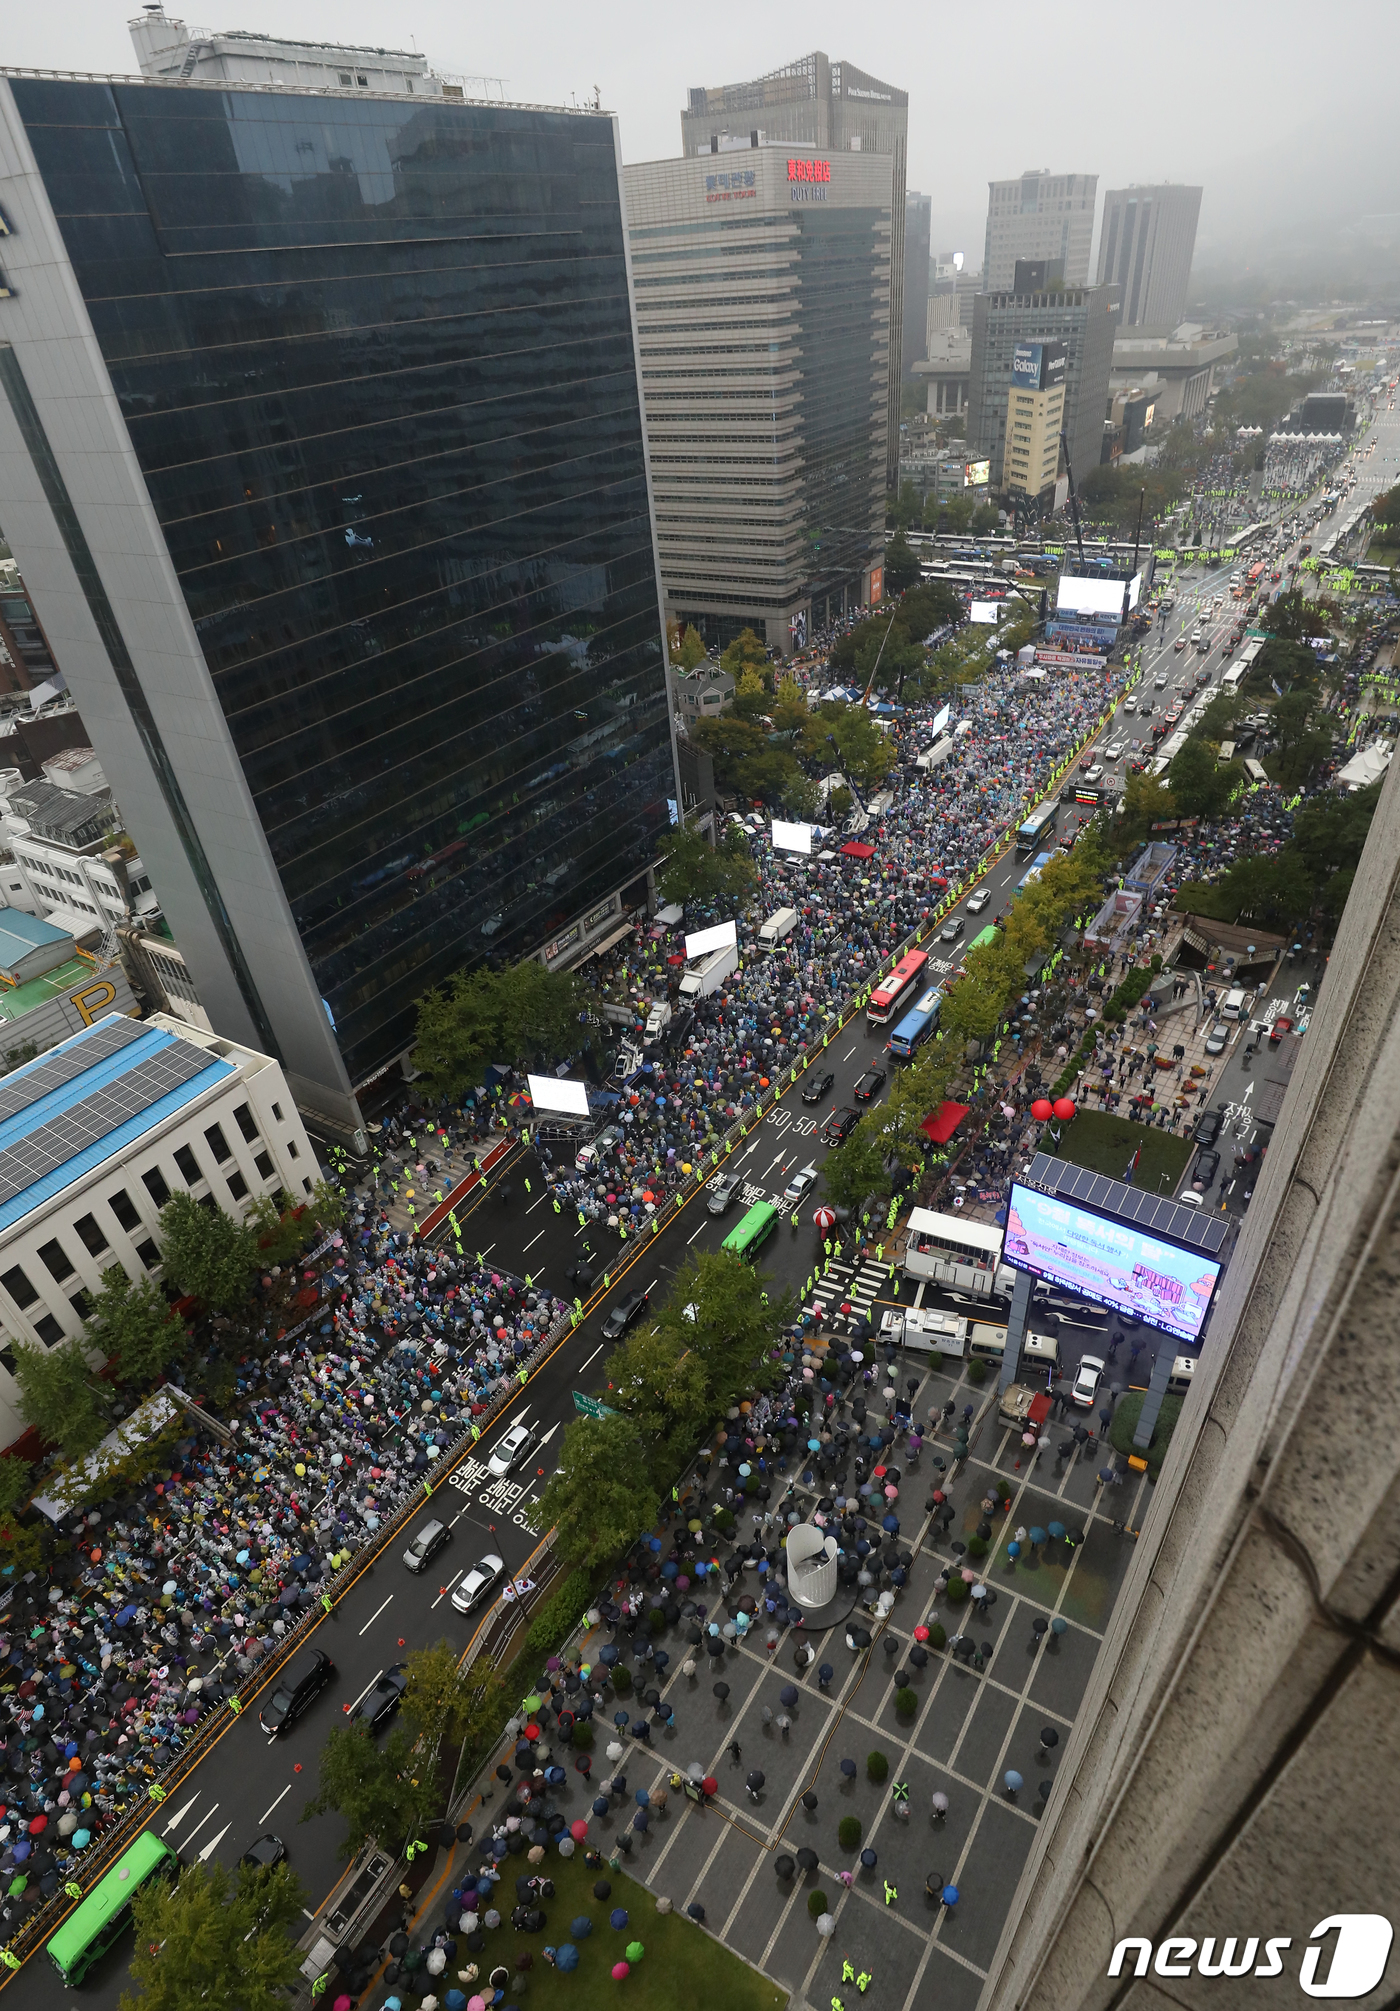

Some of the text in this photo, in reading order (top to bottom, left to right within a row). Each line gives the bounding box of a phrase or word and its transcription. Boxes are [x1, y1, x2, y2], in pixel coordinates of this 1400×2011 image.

[791, 187, 828, 201] DUTY FREE
[1014, 359, 1039, 377] Galaxy
[70, 980, 117, 1028] P
[766, 1107, 791, 1126] 50
[792, 1116, 817, 1135] 50
[1075, 1215, 1135, 1251] 독서의
[1042, 1271, 1055, 1282] 9월
[1082, 1286, 1103, 1302] 공매도
[1103, 1297, 1119, 1310] 40%
[448, 1456, 490, 1496] 광화문
